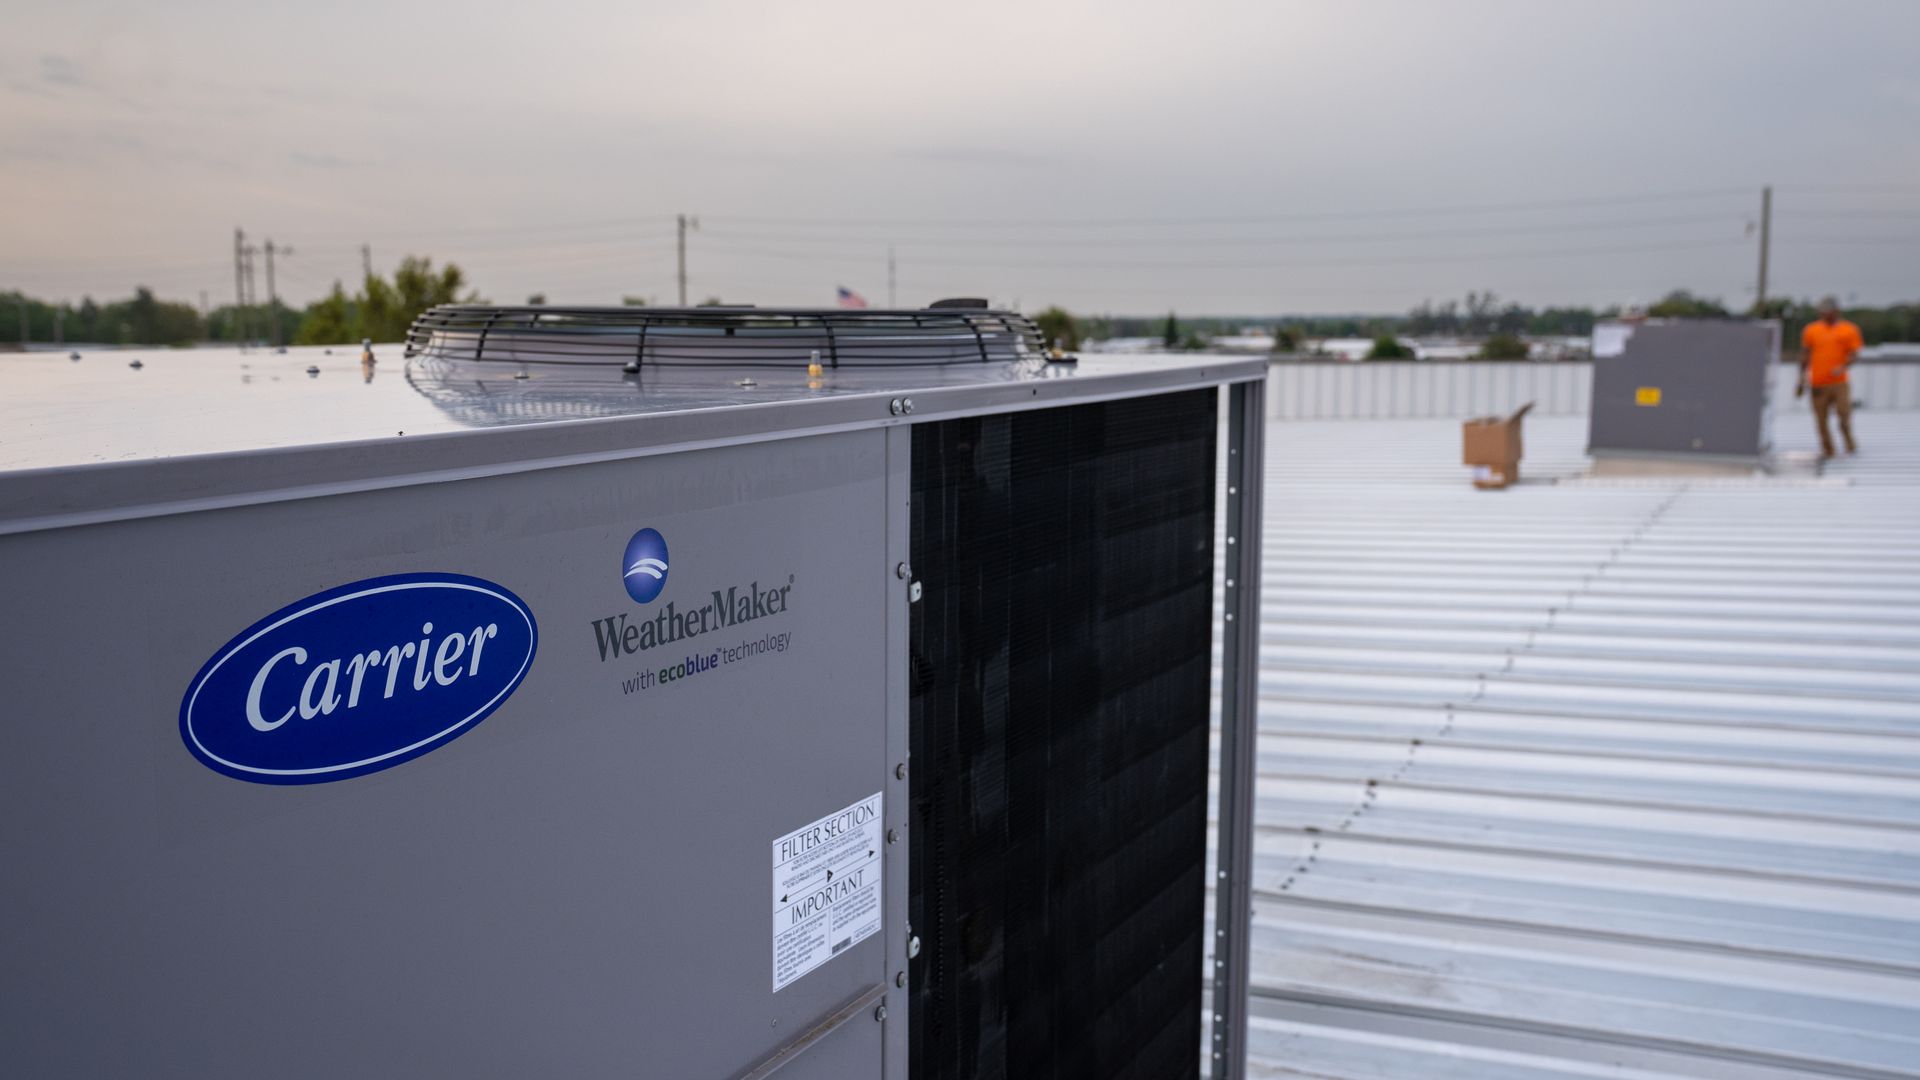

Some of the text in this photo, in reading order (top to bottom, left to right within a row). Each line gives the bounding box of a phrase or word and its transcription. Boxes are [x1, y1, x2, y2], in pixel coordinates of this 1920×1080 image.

[246, 622, 498, 732] Carrier
[622, 669, 655, 695] with
[722, 632, 792, 664] technology
[781, 827, 821, 862] FILTER
[824, 801, 874, 841] SECTION
[791, 869, 864, 924] IMPORTANT
